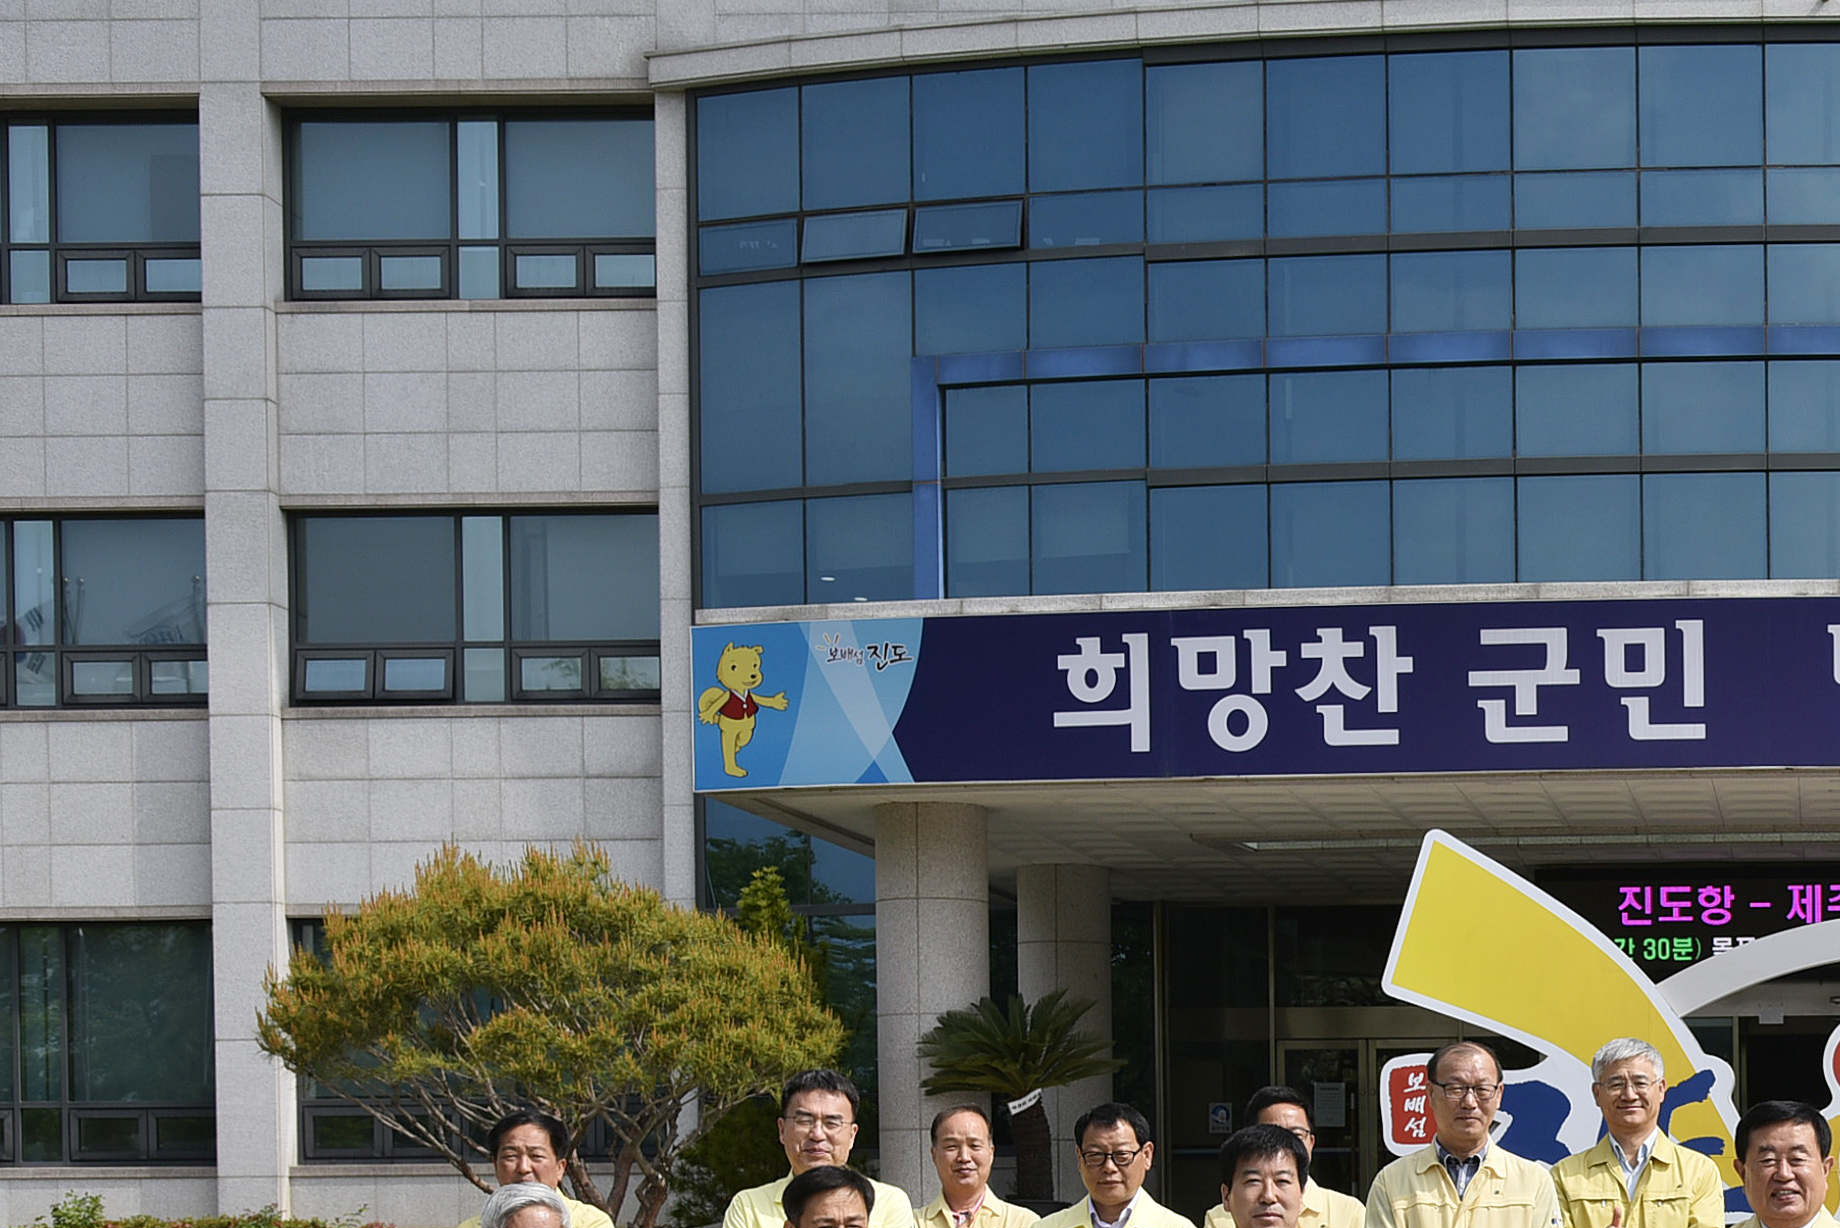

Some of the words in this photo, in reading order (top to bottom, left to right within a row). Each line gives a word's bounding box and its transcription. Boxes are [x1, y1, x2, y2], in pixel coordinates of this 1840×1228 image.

[866, 642, 912, 671] 진도
[1053, 626, 1413, 752] 희망찬
[1468, 620, 1706, 743] 군민
[1618, 885, 1735, 926] 진도항
[1643, 937, 1701, 961] 30분)
[1403, 1072, 1427, 1138] 보배섬
